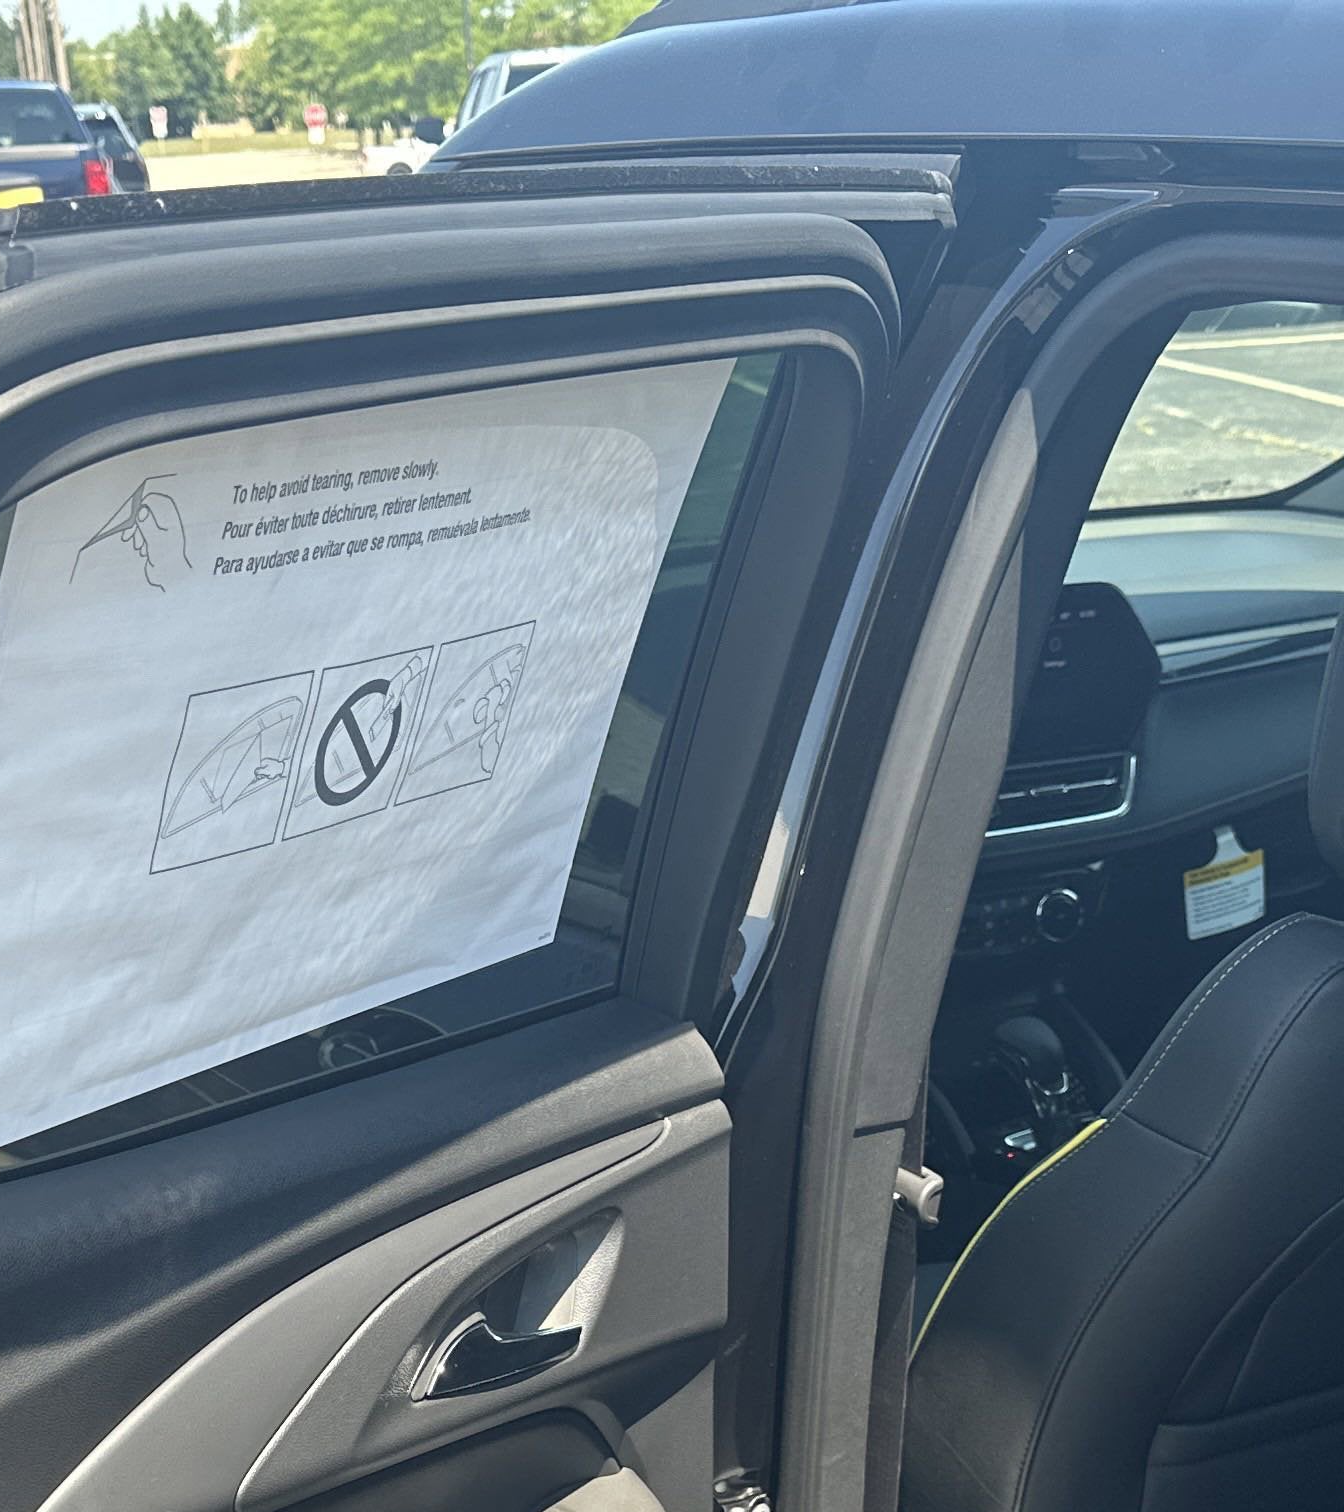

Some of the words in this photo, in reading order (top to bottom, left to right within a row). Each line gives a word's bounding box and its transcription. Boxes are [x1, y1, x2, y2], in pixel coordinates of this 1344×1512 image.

[233, 484, 248, 504] To
[250, 482, 276, 503] help
[279, 475, 310, 497] avoid
[312, 469, 354, 491] tearing,
[357, 466, 400, 484] remove
[402, 459, 439, 480] slowly.
[222, 521, 253, 540] Pour
[254, 514, 289, 536] éviter
[290, 508, 319, 529] toute
[321, 503, 378, 524] déchirure,
[382, 497, 417, 516] retirer
[213, 556, 243, 575] Para
[245, 547, 300, 574] ayudarse
[301, 547, 310, 560] a
[312, 539, 346, 559] evitar
[346, 538, 368, 558] que
[370, 536, 384, 551] se
[387, 529, 424, 550] rompa,
[427, 519, 478, 542] remuévala
